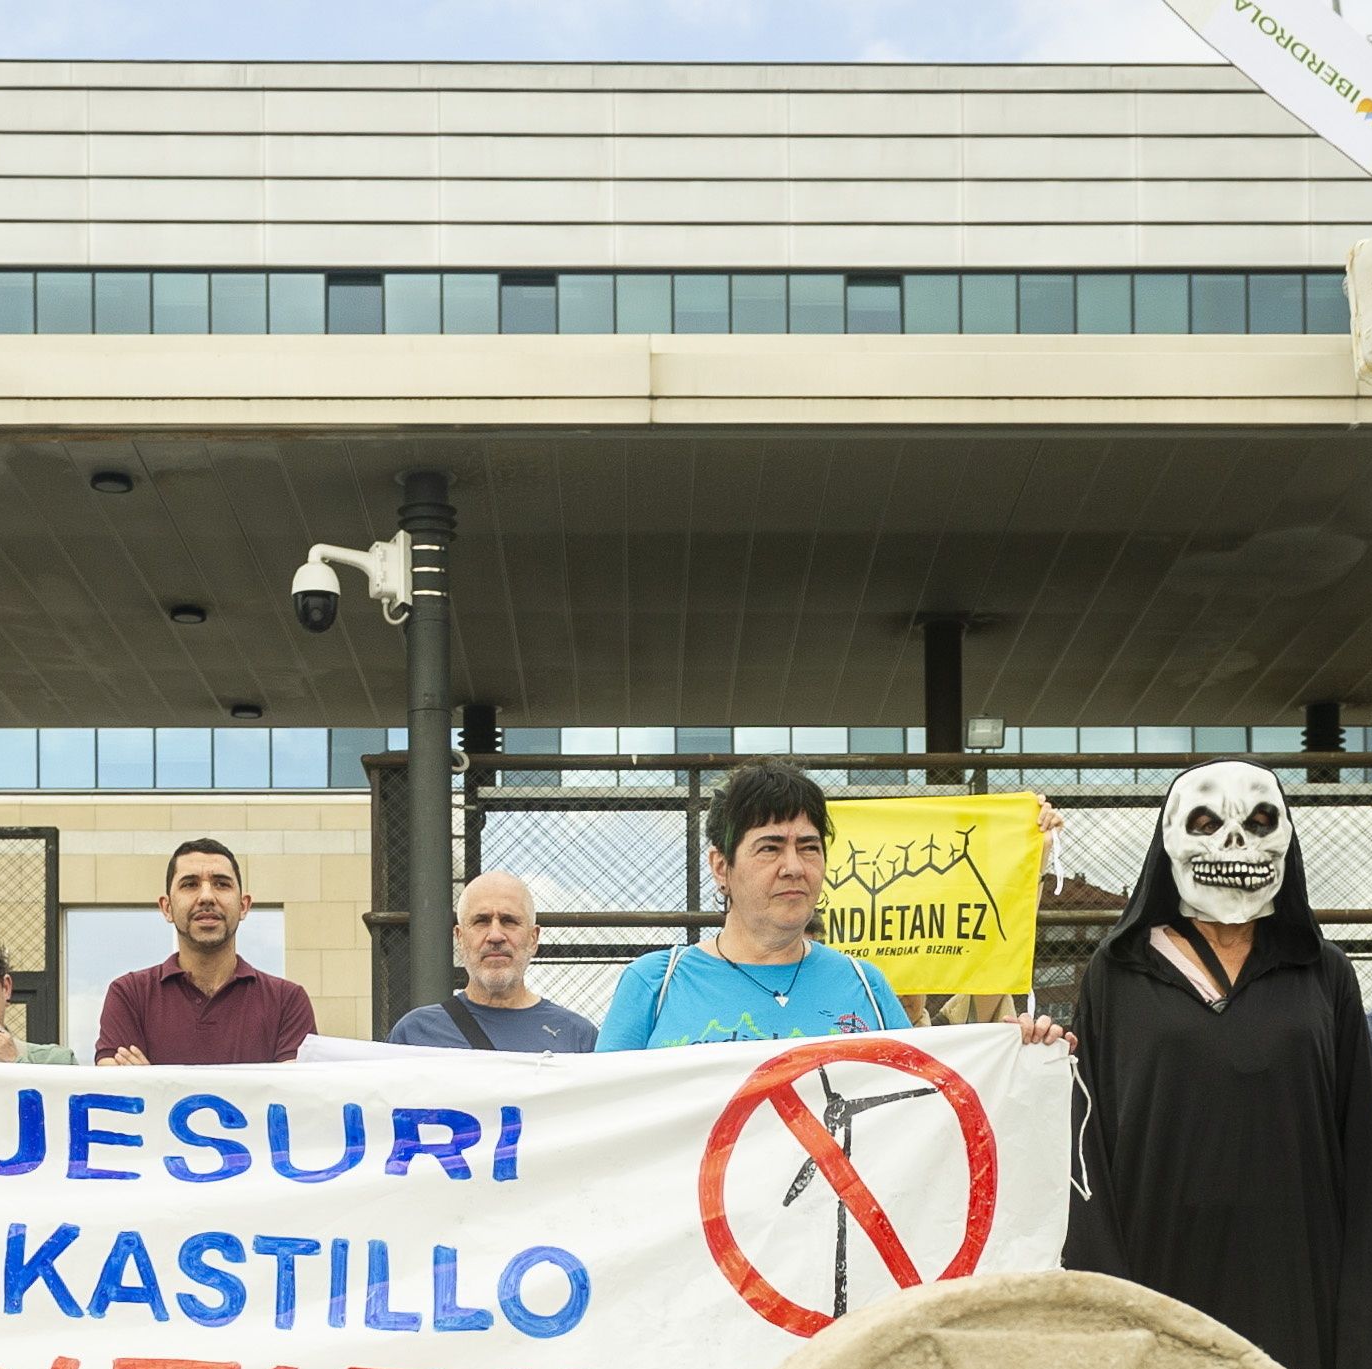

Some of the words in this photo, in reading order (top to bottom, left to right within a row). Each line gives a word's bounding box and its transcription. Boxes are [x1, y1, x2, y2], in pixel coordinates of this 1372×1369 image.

[1233, 0, 1361, 103] IBERDROLA
[819, 903, 945, 945] NDIETAN
[956, 903, 988, 941] EZ
[875, 945, 921, 957] MENDIAK
[3, 1221, 592, 1340] KASTILLO
